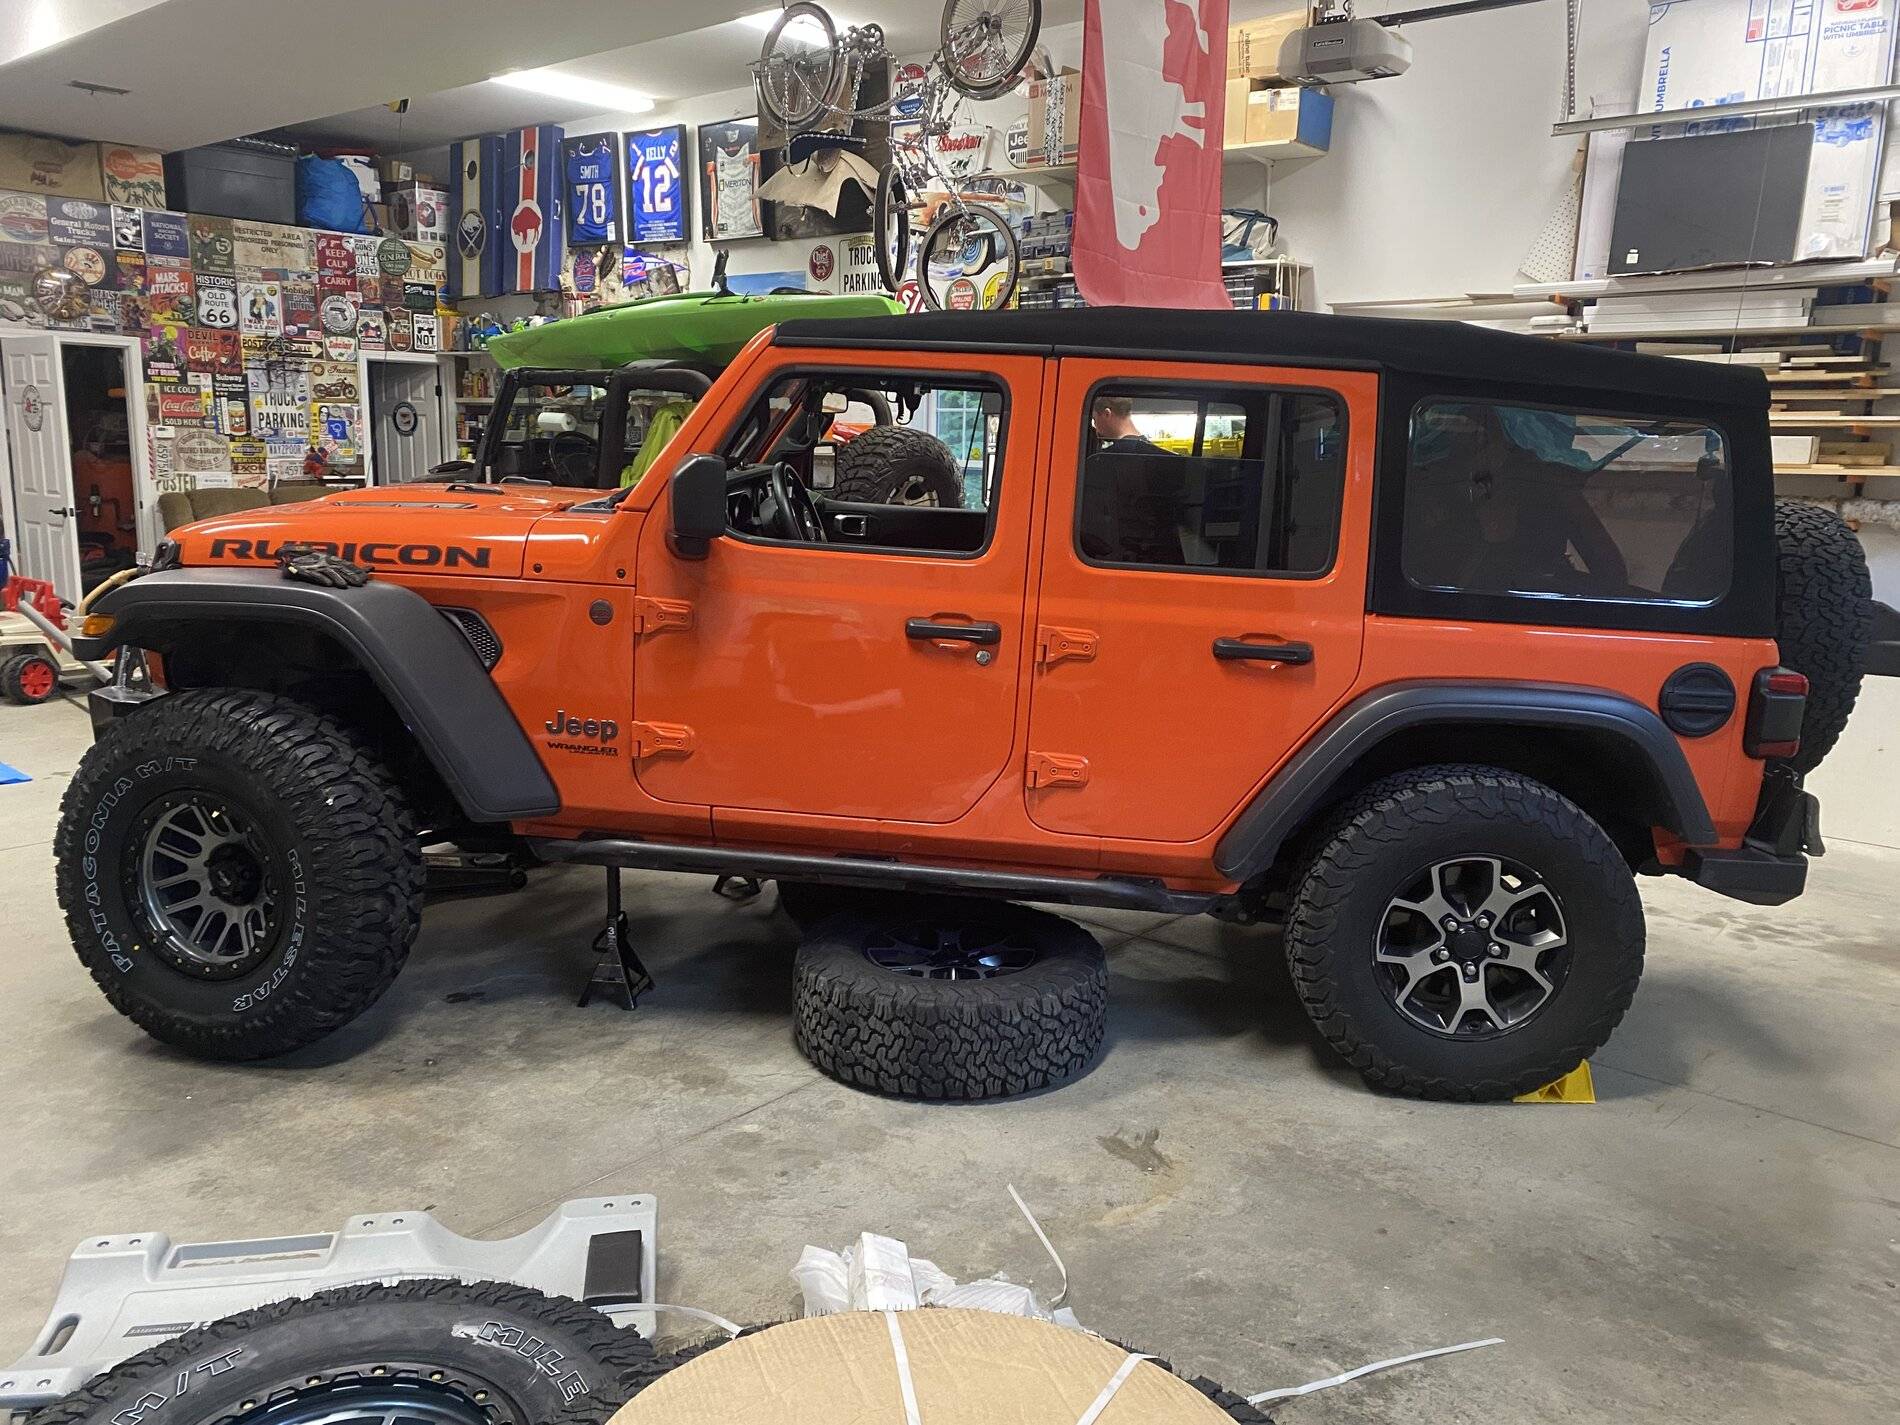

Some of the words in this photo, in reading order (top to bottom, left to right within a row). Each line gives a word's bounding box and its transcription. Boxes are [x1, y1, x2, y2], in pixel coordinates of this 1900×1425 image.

[1824, 24, 1857, 34] PICNIC
[1859, 20, 1888, 29] TABLE
[1846, 28, 1888, 38] UMBRELLA
[1655, 46, 1671, 112] UMBRELLA
[646, 145, 667, 161] KELLY
[580, 165, 599, 179] SMITH
[641, 164, 672, 213] 12
[576, 183, 605, 225] 78
[50, 217, 82, 228] General
[83, 221, 110, 232] Motors
[150, 221, 182, 231] NATIONAL
[67, 226, 96, 237] Trucks
[154, 233, 180, 241] SOCIETY
[234, 227, 272, 237] RESTRICTED
[281, 232, 301, 241] AREA
[326, 249, 347, 257] KEEP
[379, 253, 410, 261] GENERAL
[326, 259, 348, 268] CALM
[356, 266, 378, 275] EASY?
[404, 268, 420, 279] HOT
[424, 269, 447, 280] DOGS
[155, 272, 180, 283] MARS
[196, 275, 236, 287] HISTORIC
[324, 277, 352, 286] CARRY
[843, 271, 883, 293] PARKING
[150, 283, 189, 295] ATTACKS!
[207, 292, 226, 300] OLD
[205, 300, 230, 308] ROUTE
[206, 309, 231, 324] 66
[188, 331, 219, 341] DEVIL
[416, 334, 436, 346] NOT
[189, 346, 217, 362] Coffee
[215, 373, 243, 382] Subway
[164, 385, 176, 393] ICE
[177, 386, 197, 394] COLD
[165, 417, 182, 426] SOLD
[183, 418, 201, 426] HERE
[258, 412, 304, 428] PARKING
[156, 473, 197, 491] POSTED
[545, 709, 619, 744] Jeep
[547, 741, 618, 755] WRANGLER
[83, 777, 134, 973] PATAGONIA
[135, 756, 198, 780] M/T
[232, 848, 306, 1012] MILESTAR
